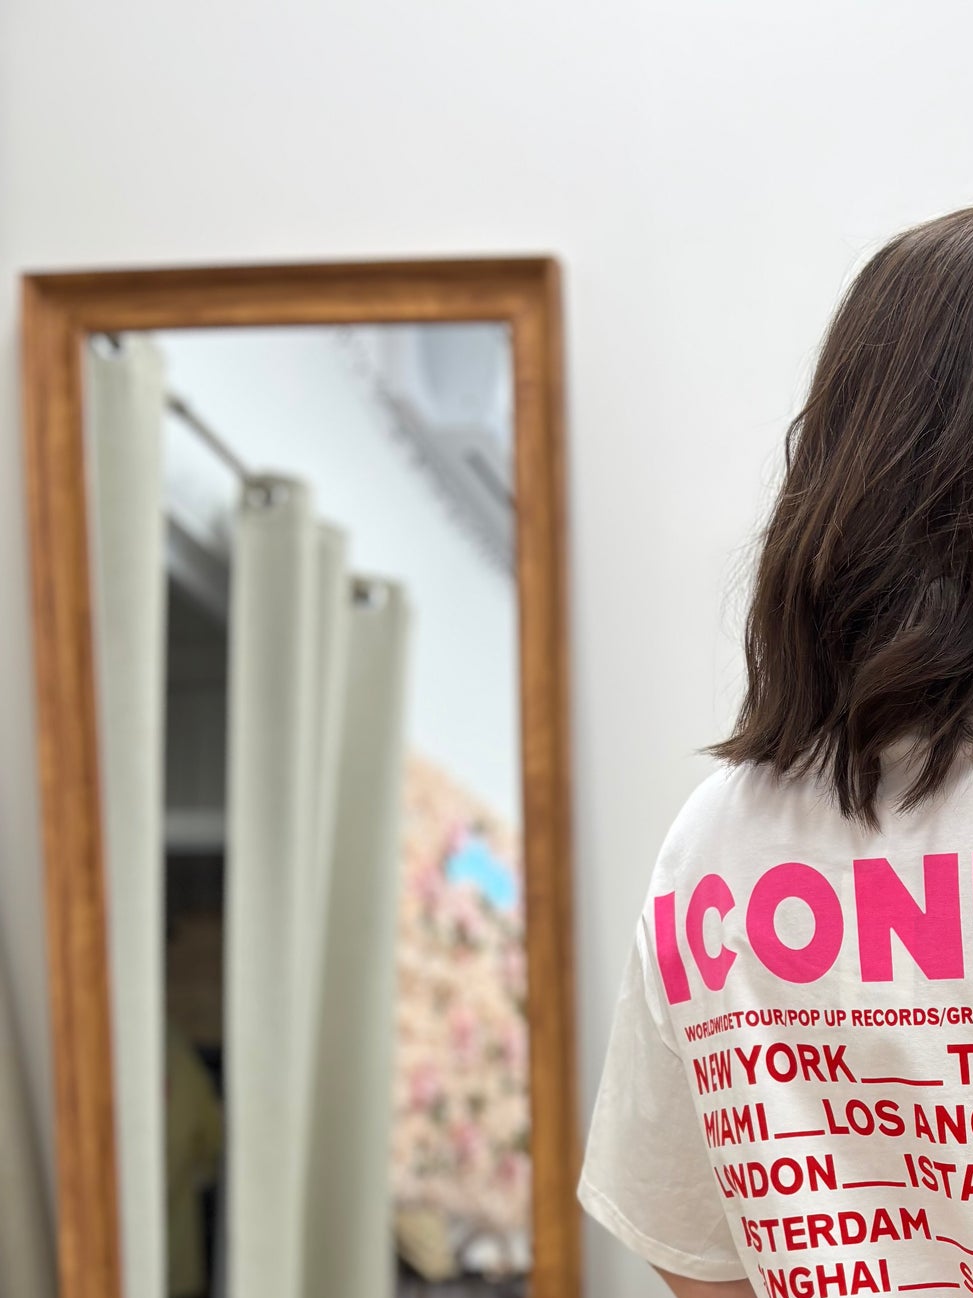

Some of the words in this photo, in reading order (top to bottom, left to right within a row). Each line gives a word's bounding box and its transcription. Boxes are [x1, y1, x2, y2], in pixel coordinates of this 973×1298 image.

[824, 1009, 847, 1028] UP
[692, 1049, 732, 1095] NEW
[821, 1098, 906, 1138] LOS
[741, 1207, 932, 1253] STERDAM
